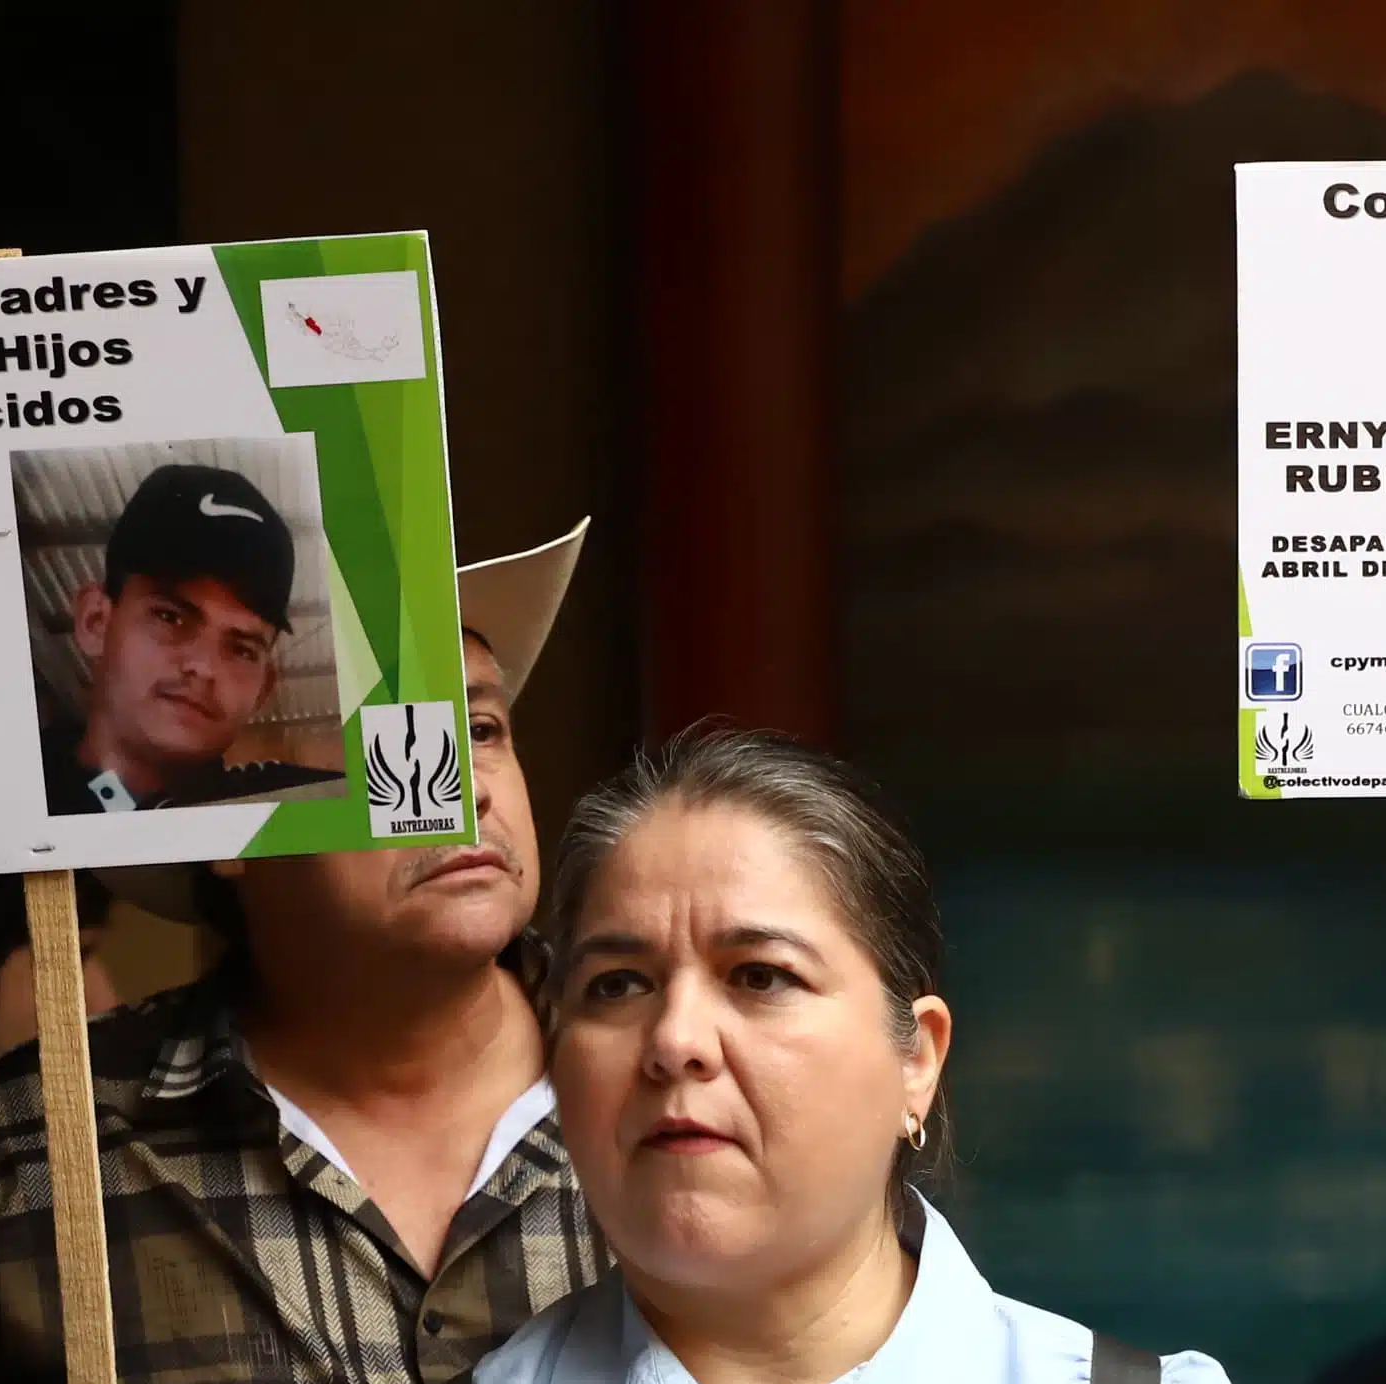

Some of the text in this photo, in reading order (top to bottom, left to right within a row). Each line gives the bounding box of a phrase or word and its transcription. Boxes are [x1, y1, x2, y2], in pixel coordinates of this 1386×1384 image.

[175, 276, 206, 313] y
[1261, 561, 1348, 579] ABRIL
[391, 818, 455, 834] RASTREADORAS
